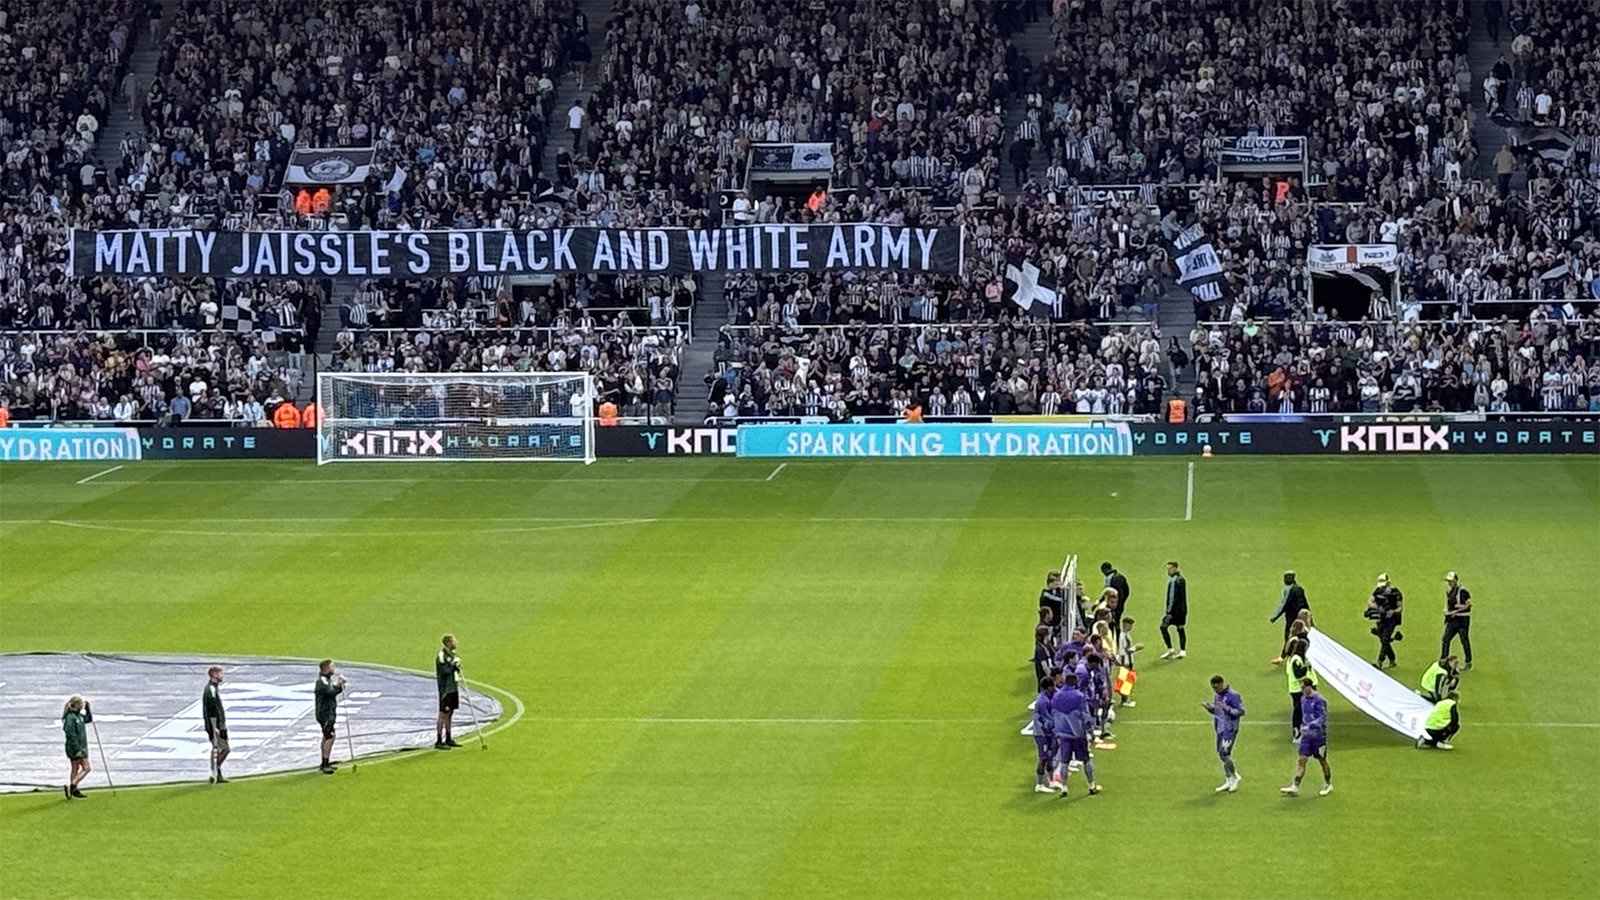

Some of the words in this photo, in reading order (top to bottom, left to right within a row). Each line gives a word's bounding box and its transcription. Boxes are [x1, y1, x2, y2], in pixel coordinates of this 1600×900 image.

[95, 231, 216, 273] MATTY
[231, 232, 430, 275] JAISSLE'S
[450, 228, 576, 271] BLACK
[593, 229, 669, 270] AND
[687, 226, 809, 270] WHITE
[826, 225, 938, 270] ARMY
[0, 438, 124, 460] YDRATION
[142, 437, 256, 448] YDRATE
[668, 429, 736, 453] KNO
[786, 432, 944, 455] SPARKLING
[960, 433, 1114, 455] HYDRATION
[1134, 432, 1251, 444] YDRATE
[1341, 426, 1449, 450] KNOX
[1453, 431, 1595, 443] HYDRATE
